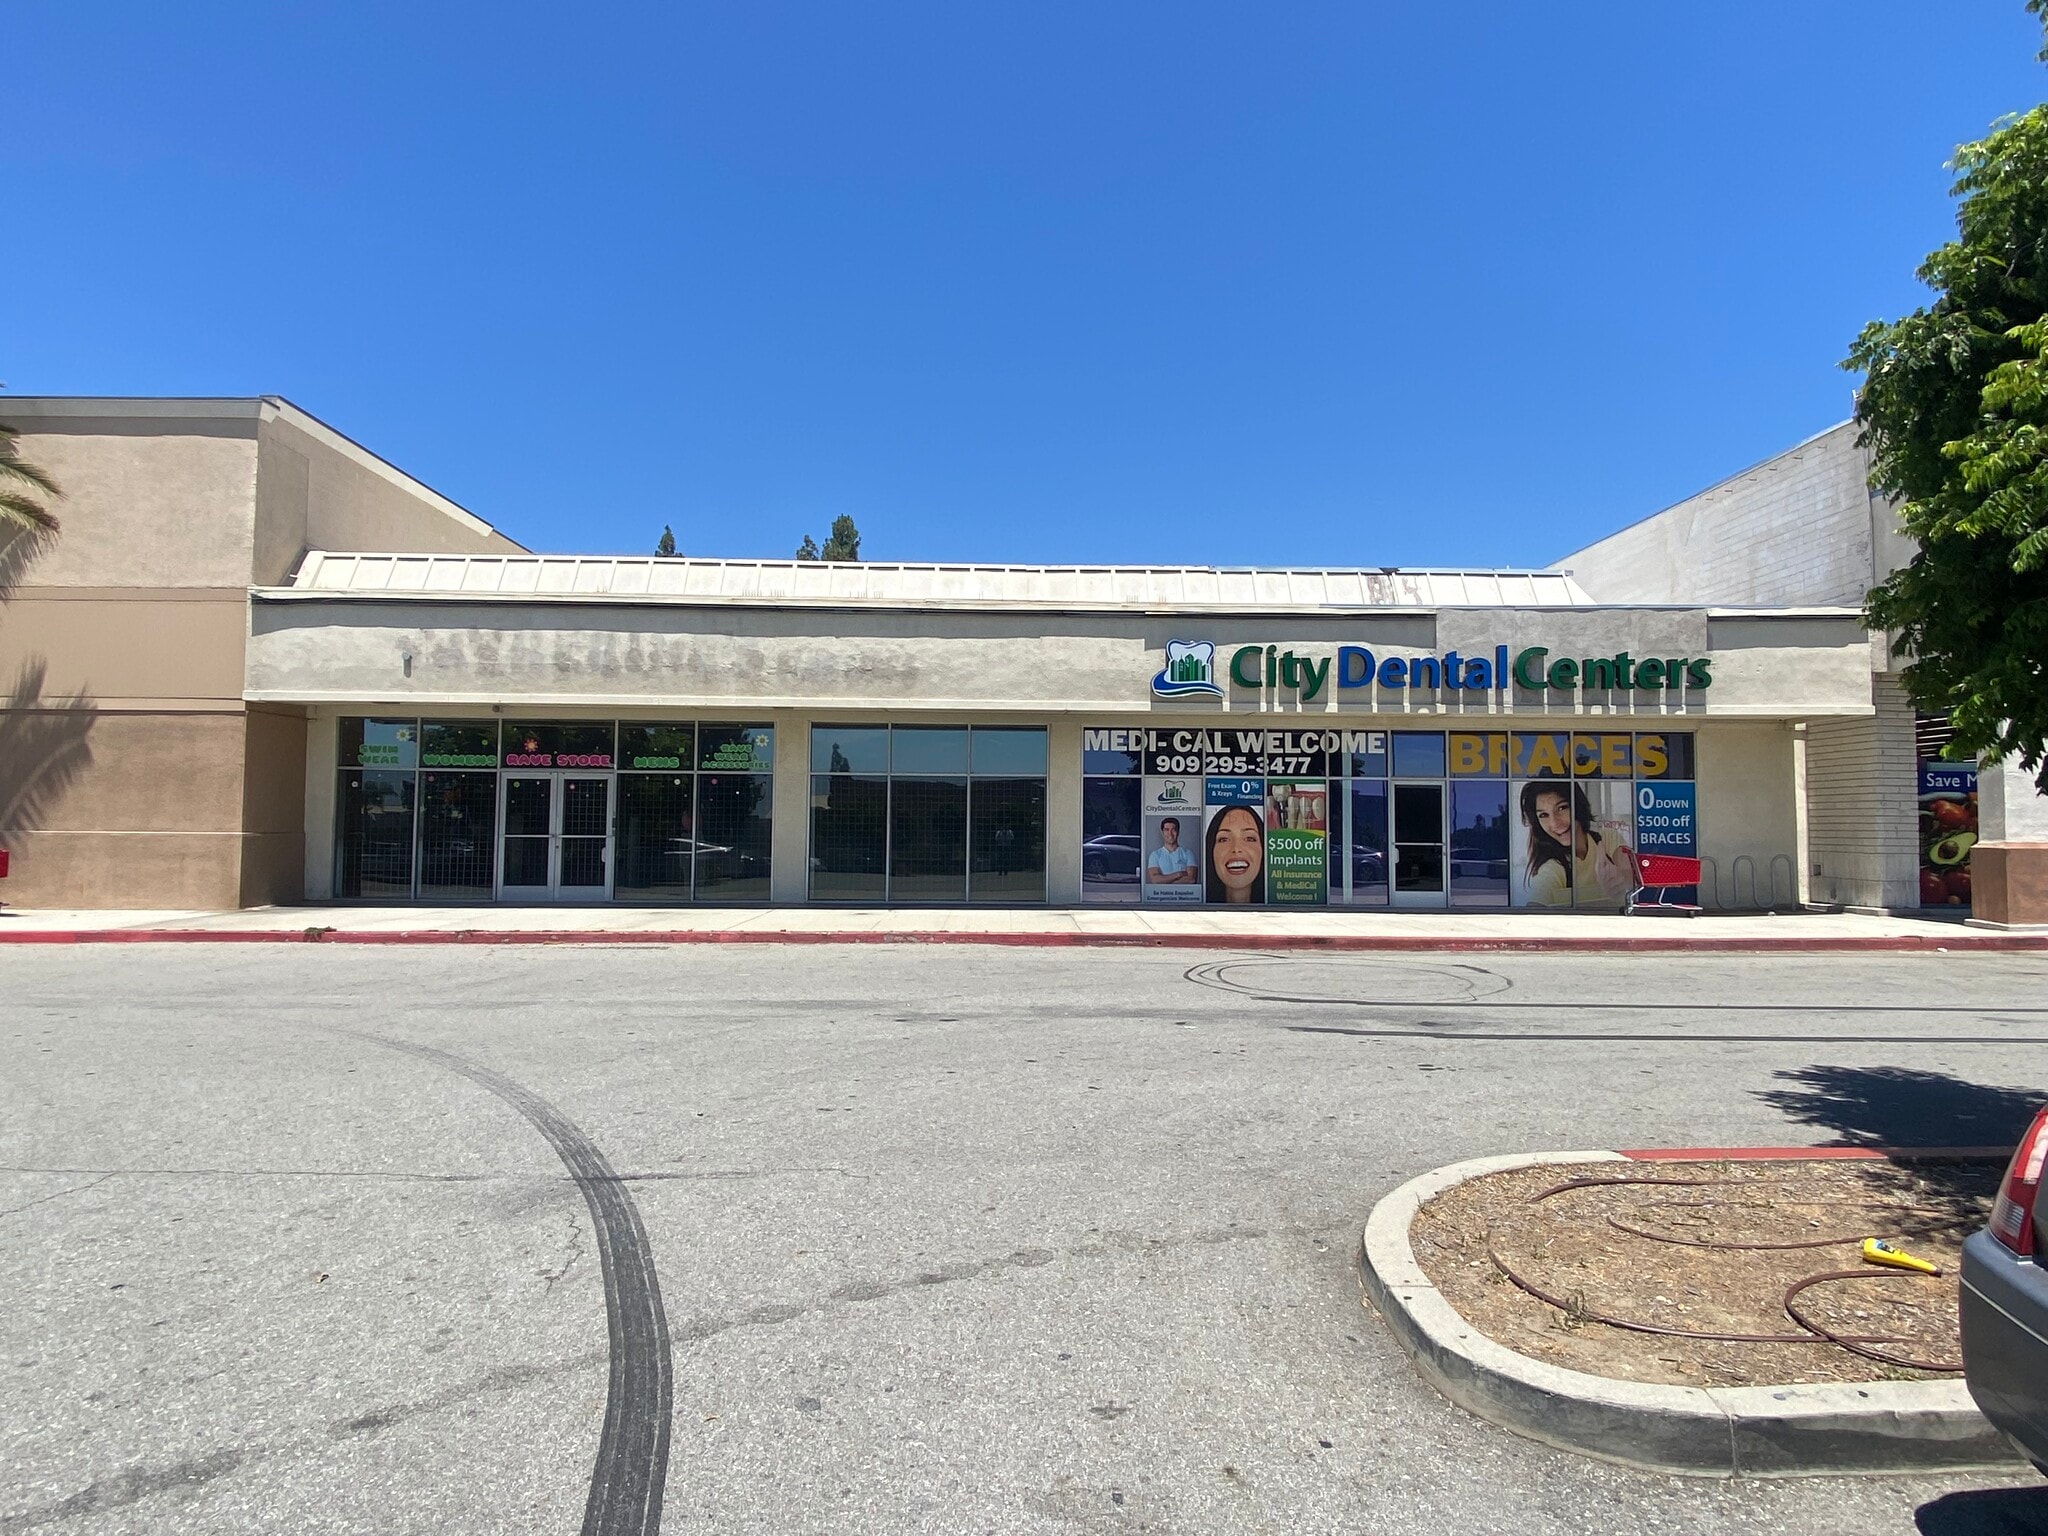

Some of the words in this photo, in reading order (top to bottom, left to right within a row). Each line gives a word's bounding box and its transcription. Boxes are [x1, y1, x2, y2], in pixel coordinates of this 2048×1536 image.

[359, 743, 399, 754] SWIM
[720, 744, 753, 753] RAVE
[1172, 730, 1231, 753] CAL
[1236, 731, 1385, 754] WELCOME
[357, 754, 399, 765] WEAR
[423, 754, 498, 766] WOMENS
[506, 754, 551, 766] RAVE
[556, 755, 611, 767] STORE
[713, 753, 749, 761] WEAR
[1451, 734, 1669, 777] BRACES
[633, 757, 680, 769] MENS
[702, 761, 770, 769] ACCESSORIES
[1156, 755, 1200, 773] 909
[1926, 772, 1961, 787] Save
[1639, 787, 1655, 810] 0
[1655, 799, 1690, 809] DOWN
[1637, 814, 1669, 828] $500
[1672, 815, 1691, 828] off
[1268, 837, 1302, 851] $500
[1304, 838, 1324, 850] off
[1640, 832, 1691, 845] BRACES
[1270, 854, 1322, 867] Implants
[1271, 870, 1282, 878] All
[1283, 870, 1322, 879] Insurance
[1276, 881, 1284, 890] &
